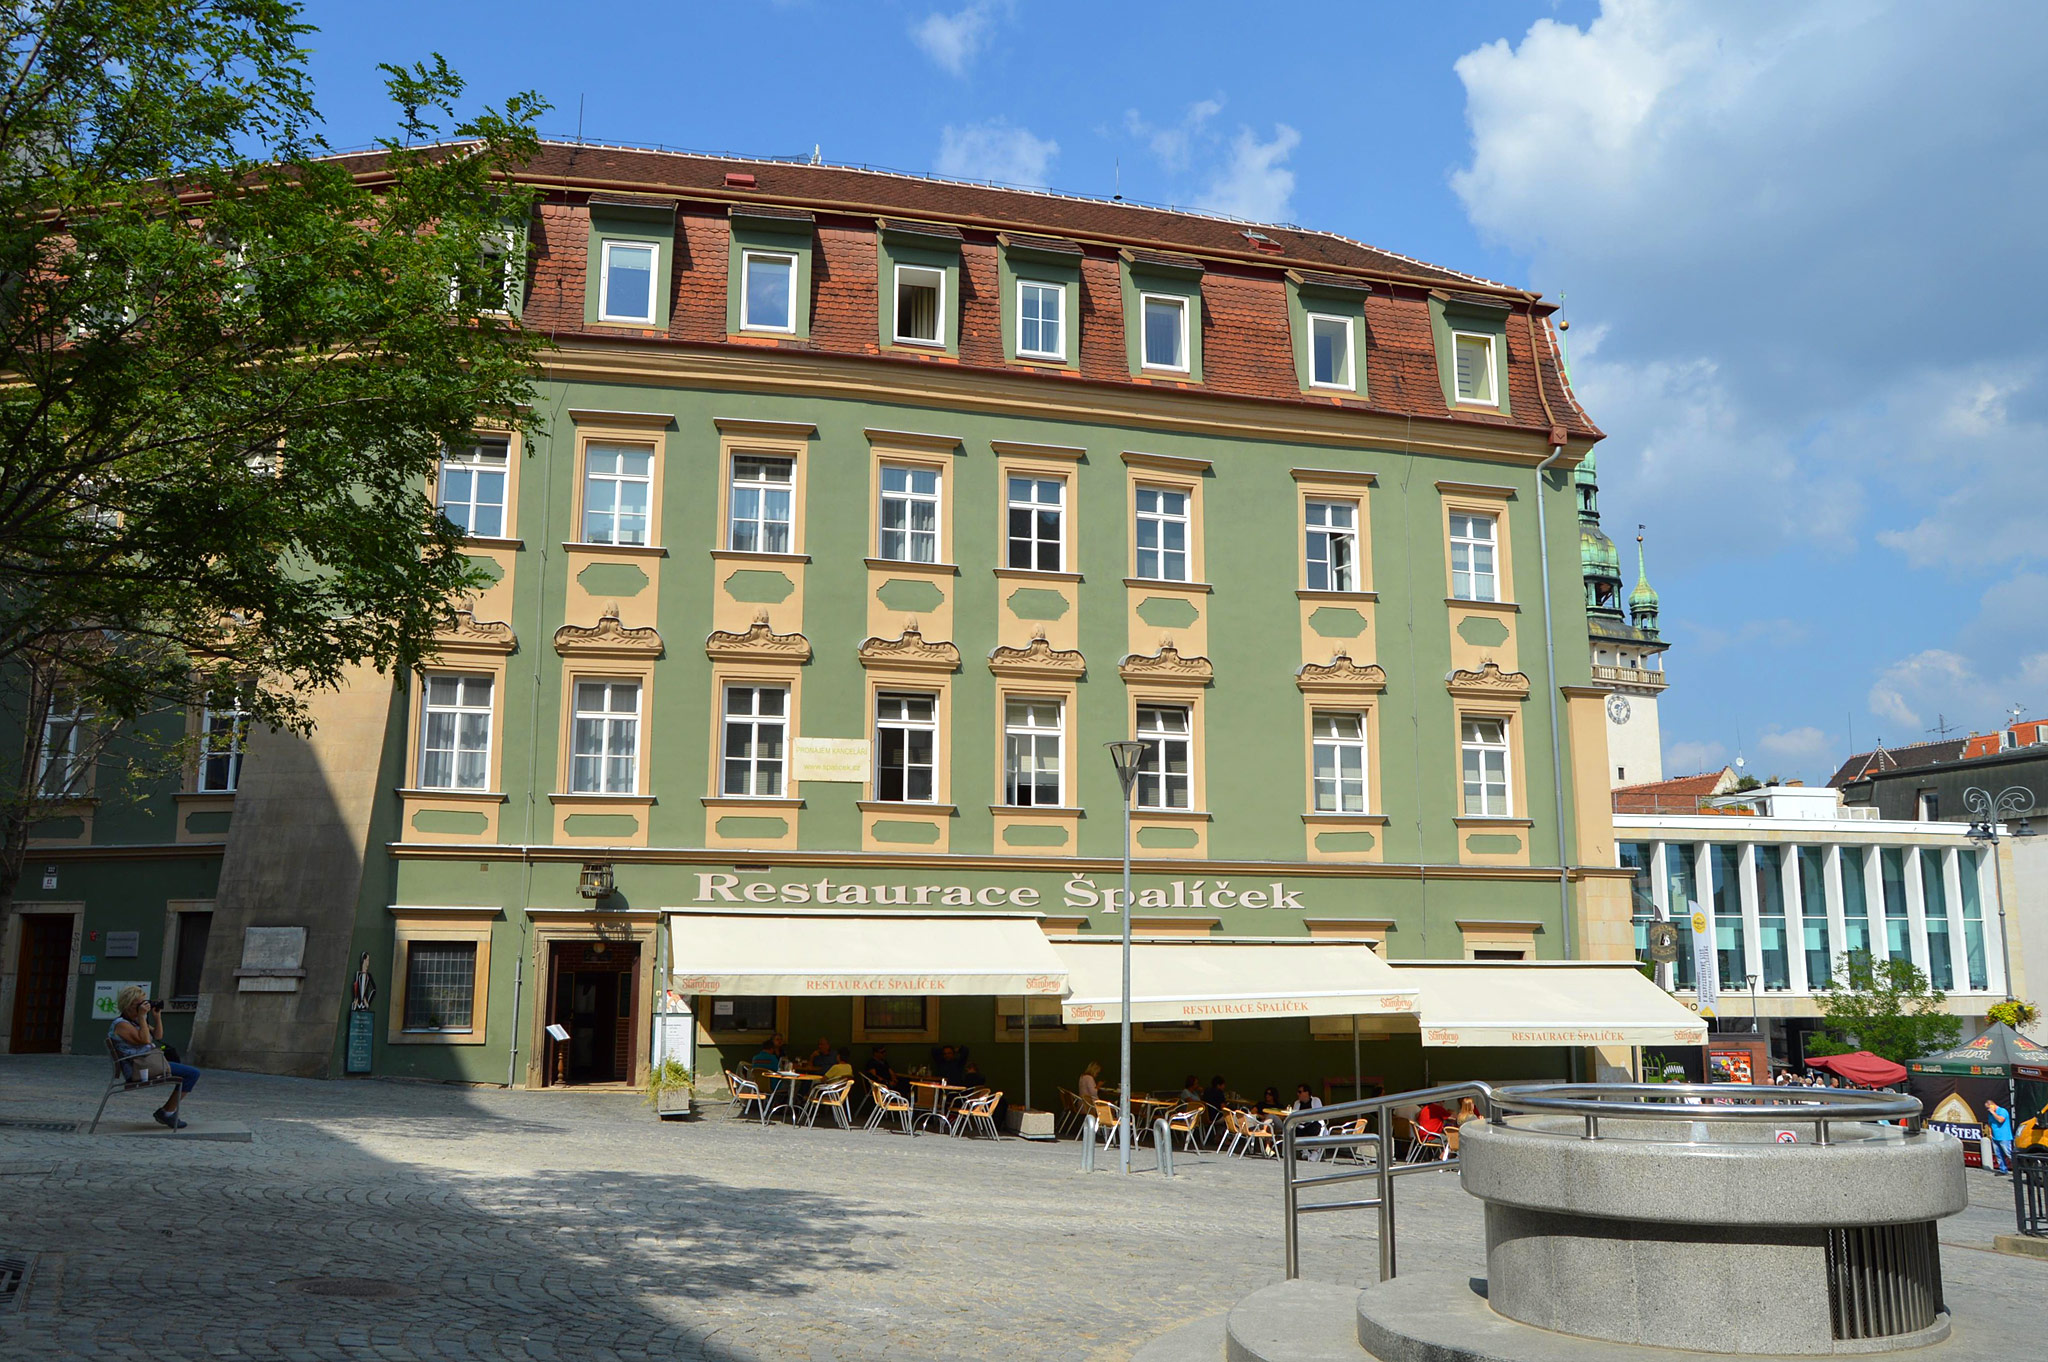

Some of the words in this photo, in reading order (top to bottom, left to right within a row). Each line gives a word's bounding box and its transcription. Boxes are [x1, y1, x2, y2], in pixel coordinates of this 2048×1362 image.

[692, 873, 1041, 907] Restaurace
[1063, 872, 1305, 914] Špalíček
[806, 979, 885, 990] RESTAURACE
[888, 977, 946, 990] ŠPALÍČEK
[1026, 976, 1061, 993] Starobrno
[1182, 1003, 1253, 1015] RESTAURACE
[1256, 1001, 1309, 1013] ŠPALÍČEK
[1380, 995, 1413, 1011] Starobrno
[1071, 1005, 1106, 1021] Starobrno
[1427, 1028, 1459, 1045] Starobrno
[1511, 1031, 1576, 1041] RESTAURACE
[1577, 1030, 1625, 1041] ŠPALÍČEK
